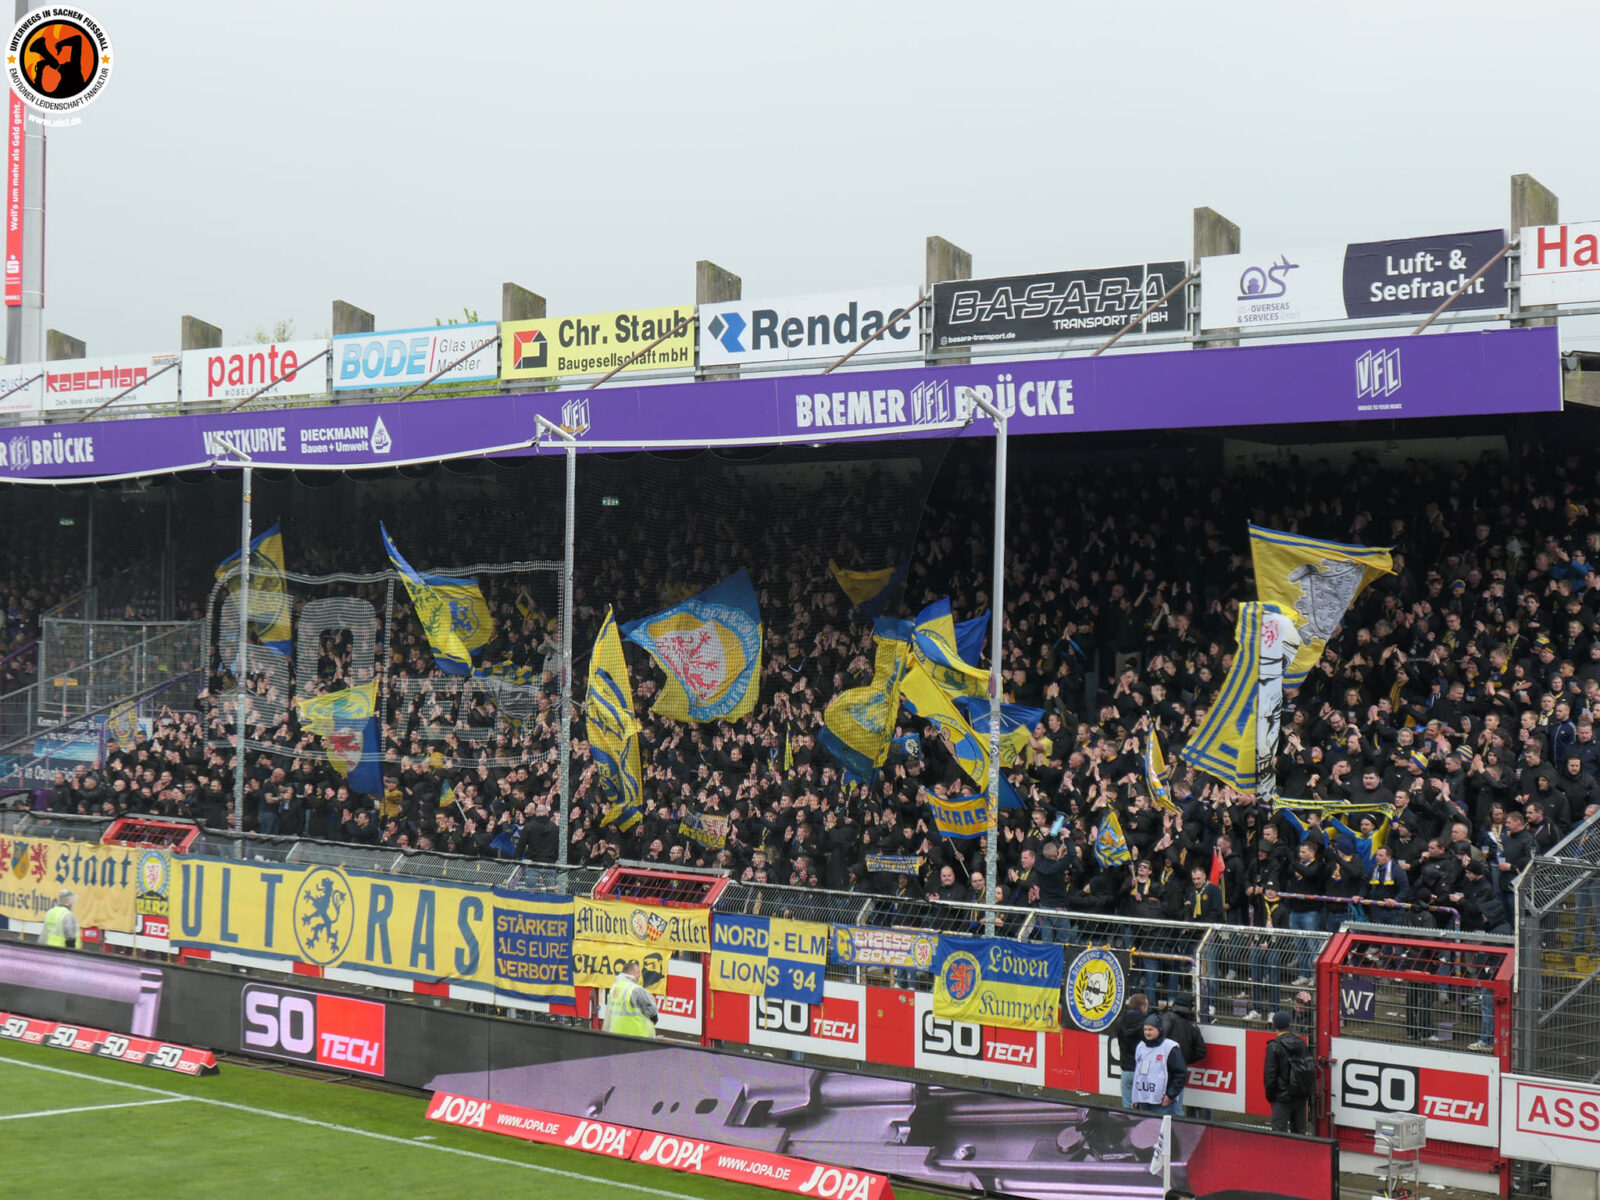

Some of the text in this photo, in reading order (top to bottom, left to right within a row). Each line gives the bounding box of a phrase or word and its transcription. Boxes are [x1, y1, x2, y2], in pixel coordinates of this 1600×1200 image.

[1386, 249, 1467, 276] Luft- &
[949, 273, 1168, 325] BASARA
[1370, 273, 1485, 303] Seefracht
[1244, 313, 1279, 323] SERVICES
[1251, 302, 1290, 313] OVERSEAS
[558, 310, 688, 348] Chr. Staub
[752, 301, 913, 350] Rendac
[1053, 314, 1127, 330] TRANSPORT
[340, 337, 429, 380] BODE
[439, 339, 466, 354] Glas
[208, 344, 298, 398] pante
[437, 358, 481, 372] Meister
[558, 347, 688, 372] Baugesellschaft mbH
[796, 389, 906, 428] BREMER
[955, 373, 1074, 420] BRÜCKE
[203, 427, 287, 455] WESTKURVE
[301, 426, 369, 442] DIECKMANN
[32, 431, 95, 465] BRÜCKE
[301, 442, 328, 454] Bauen
[336, 440, 369, 453] Umwelt
[497, 914, 568, 937] STÄRKER
[576, 907, 707, 944] Müden Aller
[715, 923, 770, 949] NORD
[498, 937, 568, 959] ALS EURE
[858, 948, 907, 964] BOYS
[497, 958, 569, 981] VERBOTE
[720, 960, 779, 987] LIONS
[988, 945, 1048, 978] Löwen
[656, 995, 694, 1015] TECH
[978, 990, 1054, 1028] Kumpelz
[1341, 989, 1374, 1011] W7
[1, 1017, 30, 1038] SO
[50, 1026, 79, 1047] SO
[245, 990, 380, 1067] SO TECH
[813, 1018, 856, 1039] TECH
[924, 1013, 1034, 1064] SO TECH
[101, 1034, 130, 1056] SO
[153, 1045, 183, 1067] SO
[1187, 1067, 1233, 1089] ECH
[1345, 1063, 1485, 1122] SO TECH
[496, 1113, 559, 1134] WWW.JOPA.DE
[1528, 1095, 1600, 1132] ASS
[717, 1155, 791, 1181] WWW.JOPA.DE
